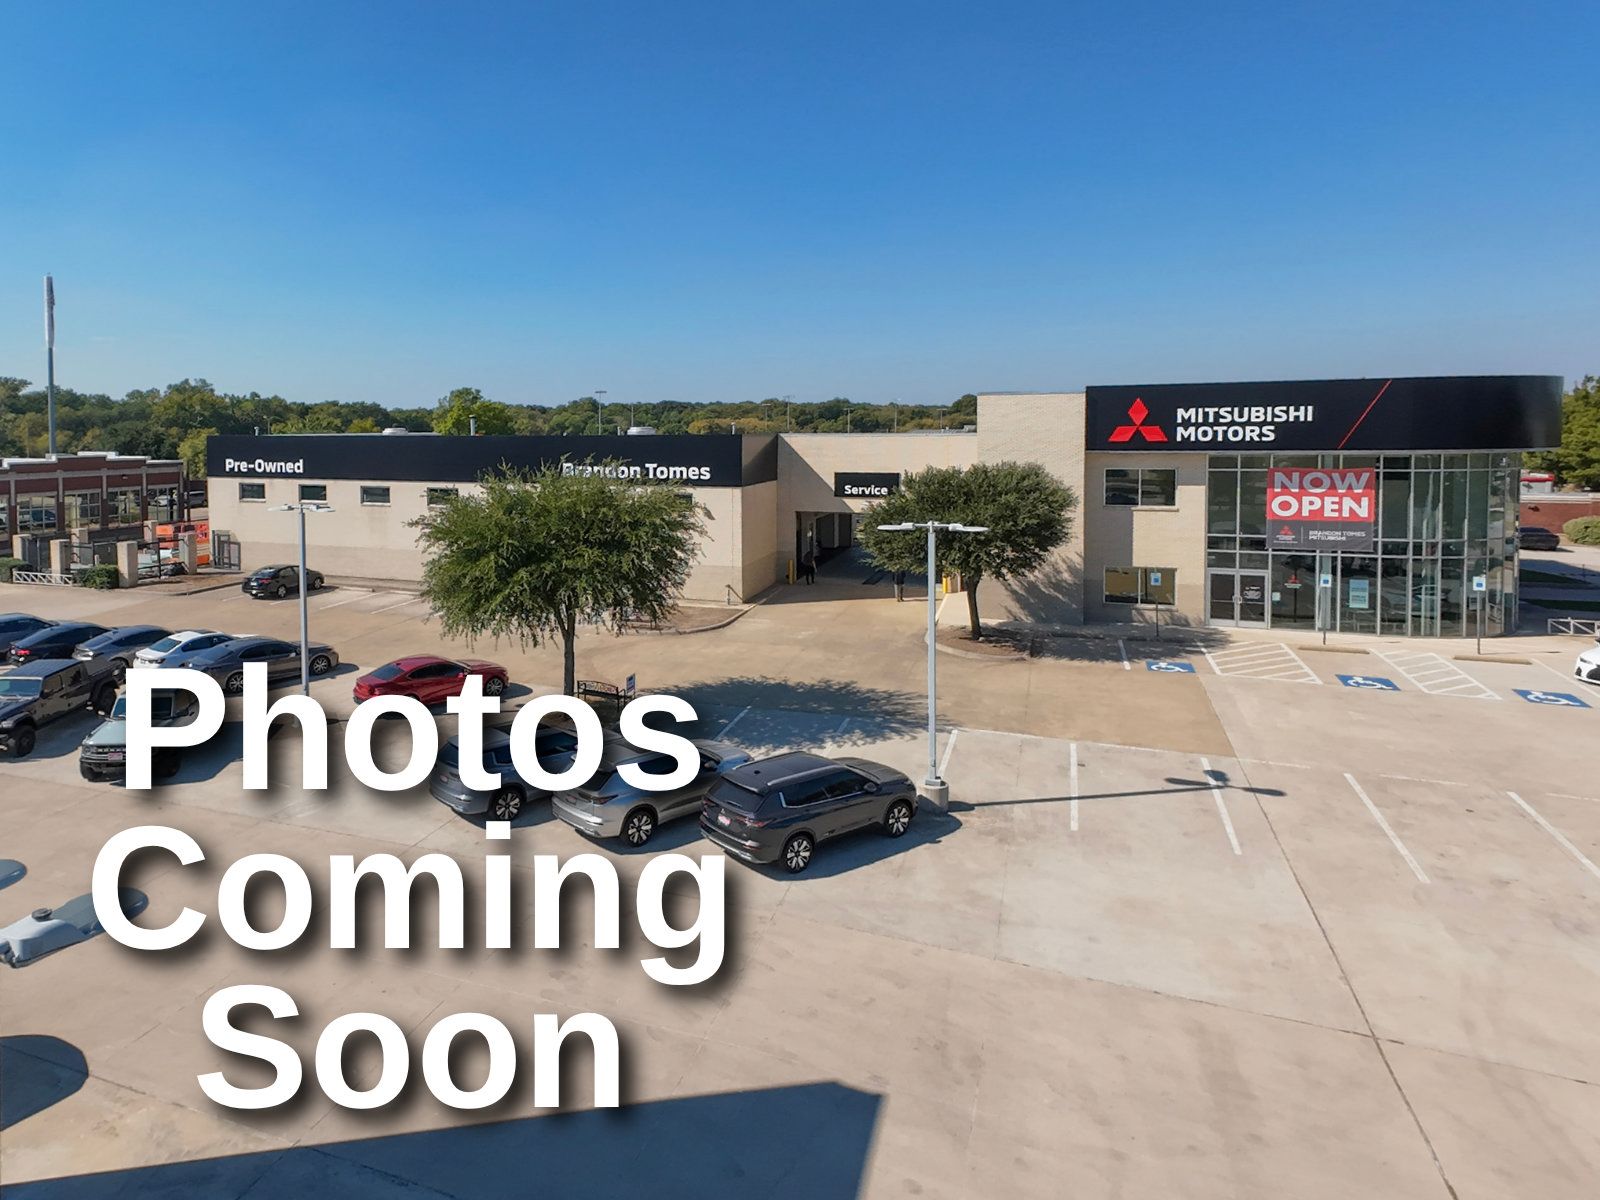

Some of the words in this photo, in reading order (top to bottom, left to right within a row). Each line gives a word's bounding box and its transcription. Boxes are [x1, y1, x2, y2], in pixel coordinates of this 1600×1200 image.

[1176, 405, 1314, 423] MITSUBISHI
[1176, 425, 1276, 442] MOTORS
[225, 458, 304, 474] Pre-Owned
[645, 463, 711, 480] Tomes
[844, 484, 889, 496] Service
[1274, 471, 1370, 493] NOW
[1271, 495, 1369, 518] OPEN
